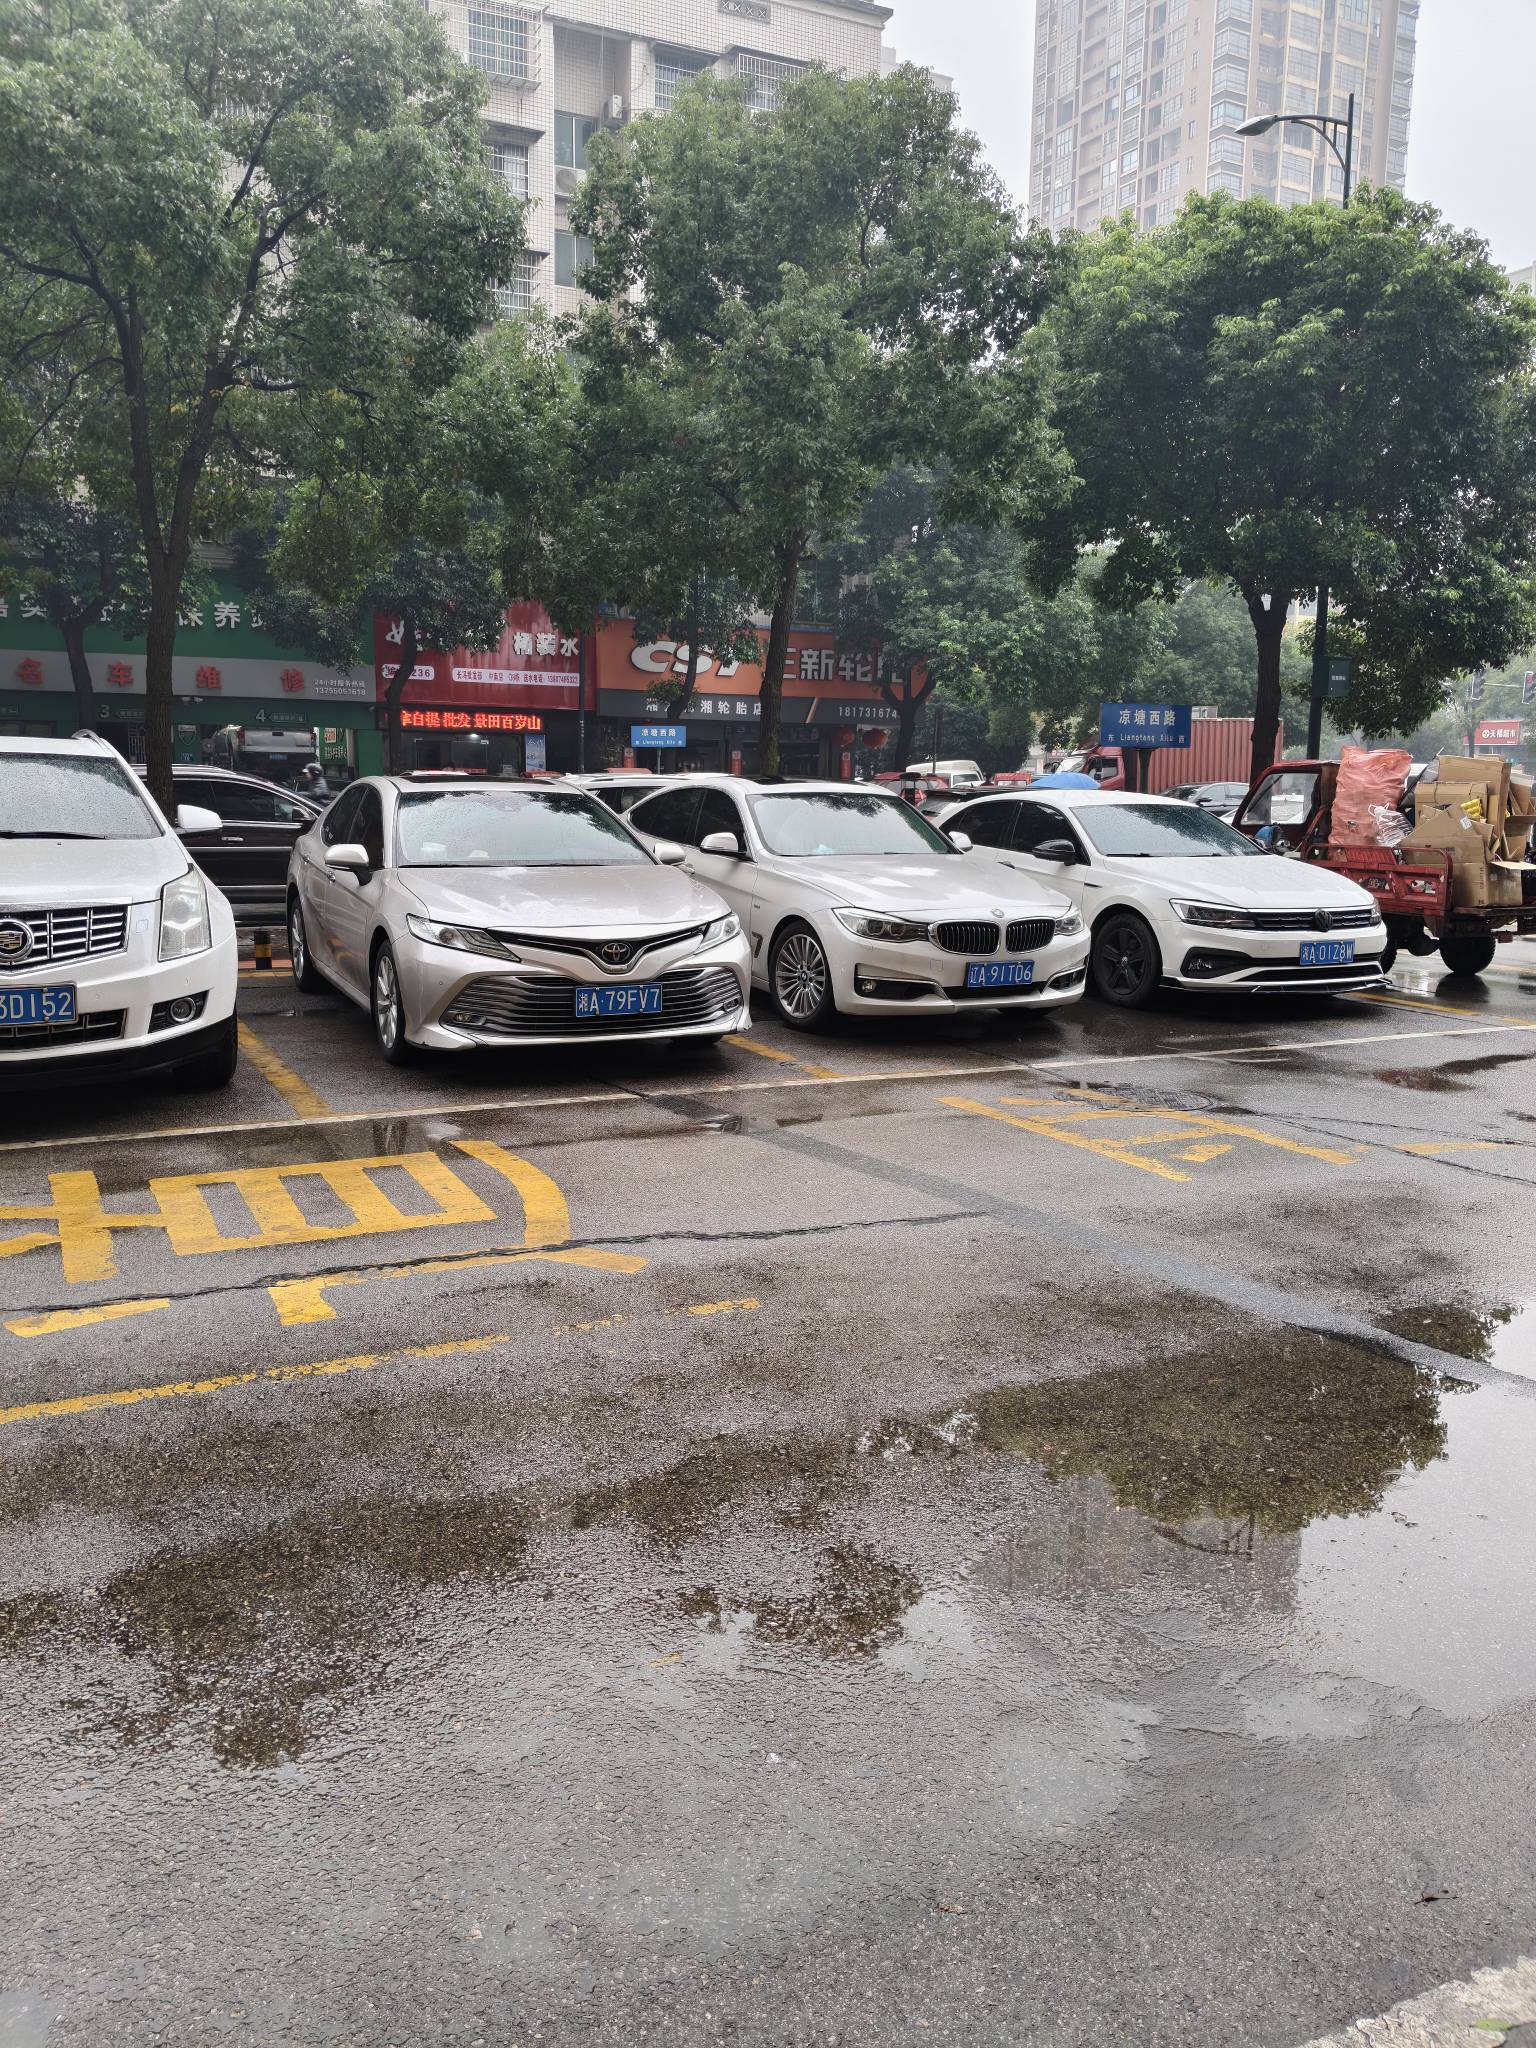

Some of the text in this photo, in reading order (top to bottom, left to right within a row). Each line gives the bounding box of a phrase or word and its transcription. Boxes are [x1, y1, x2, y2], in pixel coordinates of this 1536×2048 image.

[512, 631, 580, 656] 桶装水
[18, 657, 305, 693] 名车维修
[1119, 709, 1176, 726] 凉塘西路
